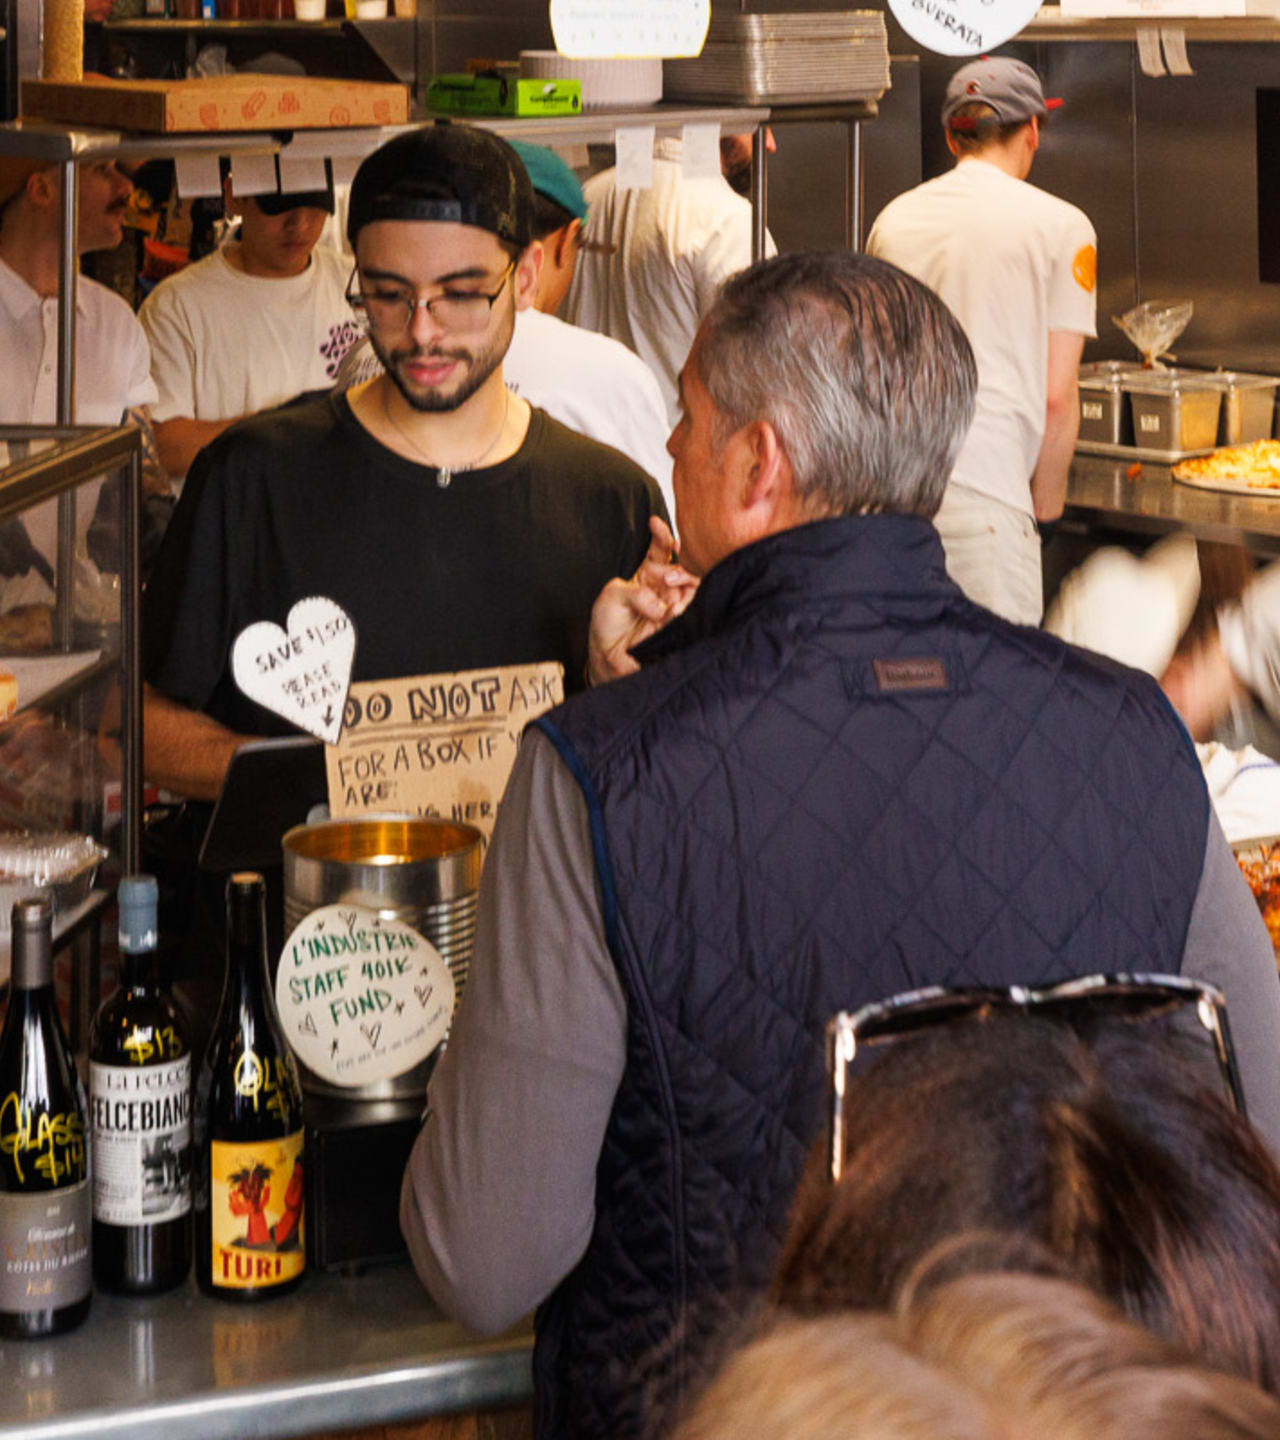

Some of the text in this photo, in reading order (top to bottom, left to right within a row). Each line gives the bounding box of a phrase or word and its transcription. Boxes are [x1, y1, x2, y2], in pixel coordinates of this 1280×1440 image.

[255, 635, 303, 674] SAVE
[343, 673, 558, 729] DO NOT ASK
[338, 736, 498, 790] FOR A BOX IF
[292, 925, 419, 968] L'INDUSTRIE
[289, 963, 350, 1006] STAFF
[329, 988, 393, 1027] FUND
[220, 1250, 284, 1281] TURI
